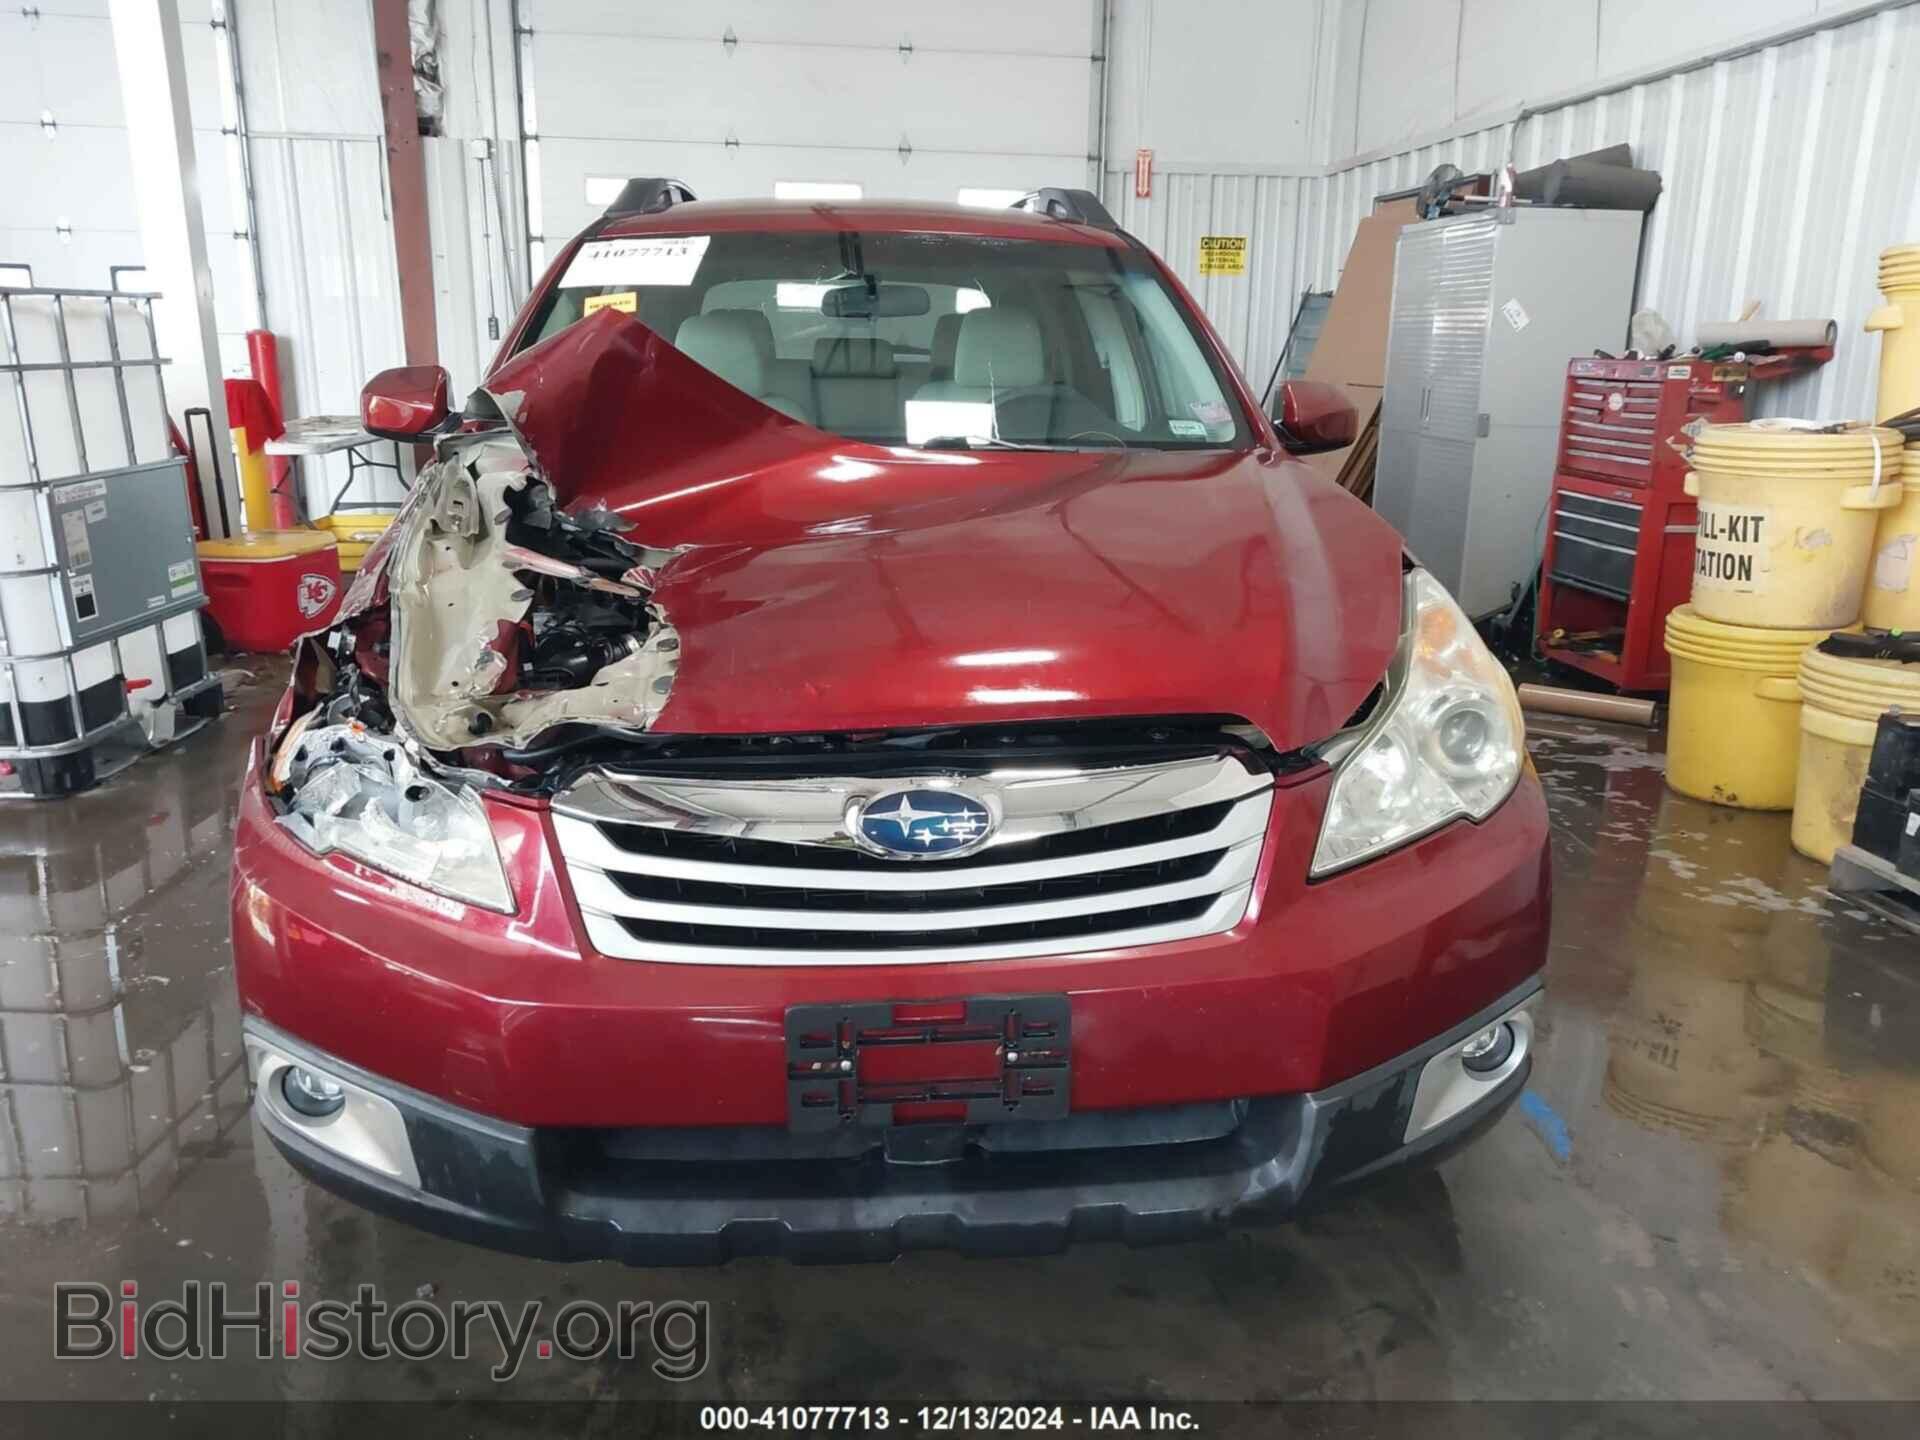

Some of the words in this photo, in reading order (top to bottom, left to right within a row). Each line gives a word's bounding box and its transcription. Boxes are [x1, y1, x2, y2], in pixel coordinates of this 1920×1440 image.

[588, 246, 688, 259] 41077713
[1202, 238, 1245, 249] CAUTION
[1696, 510, 1764, 543] PILL-KIT
[1696, 547, 1752, 581] TATION
